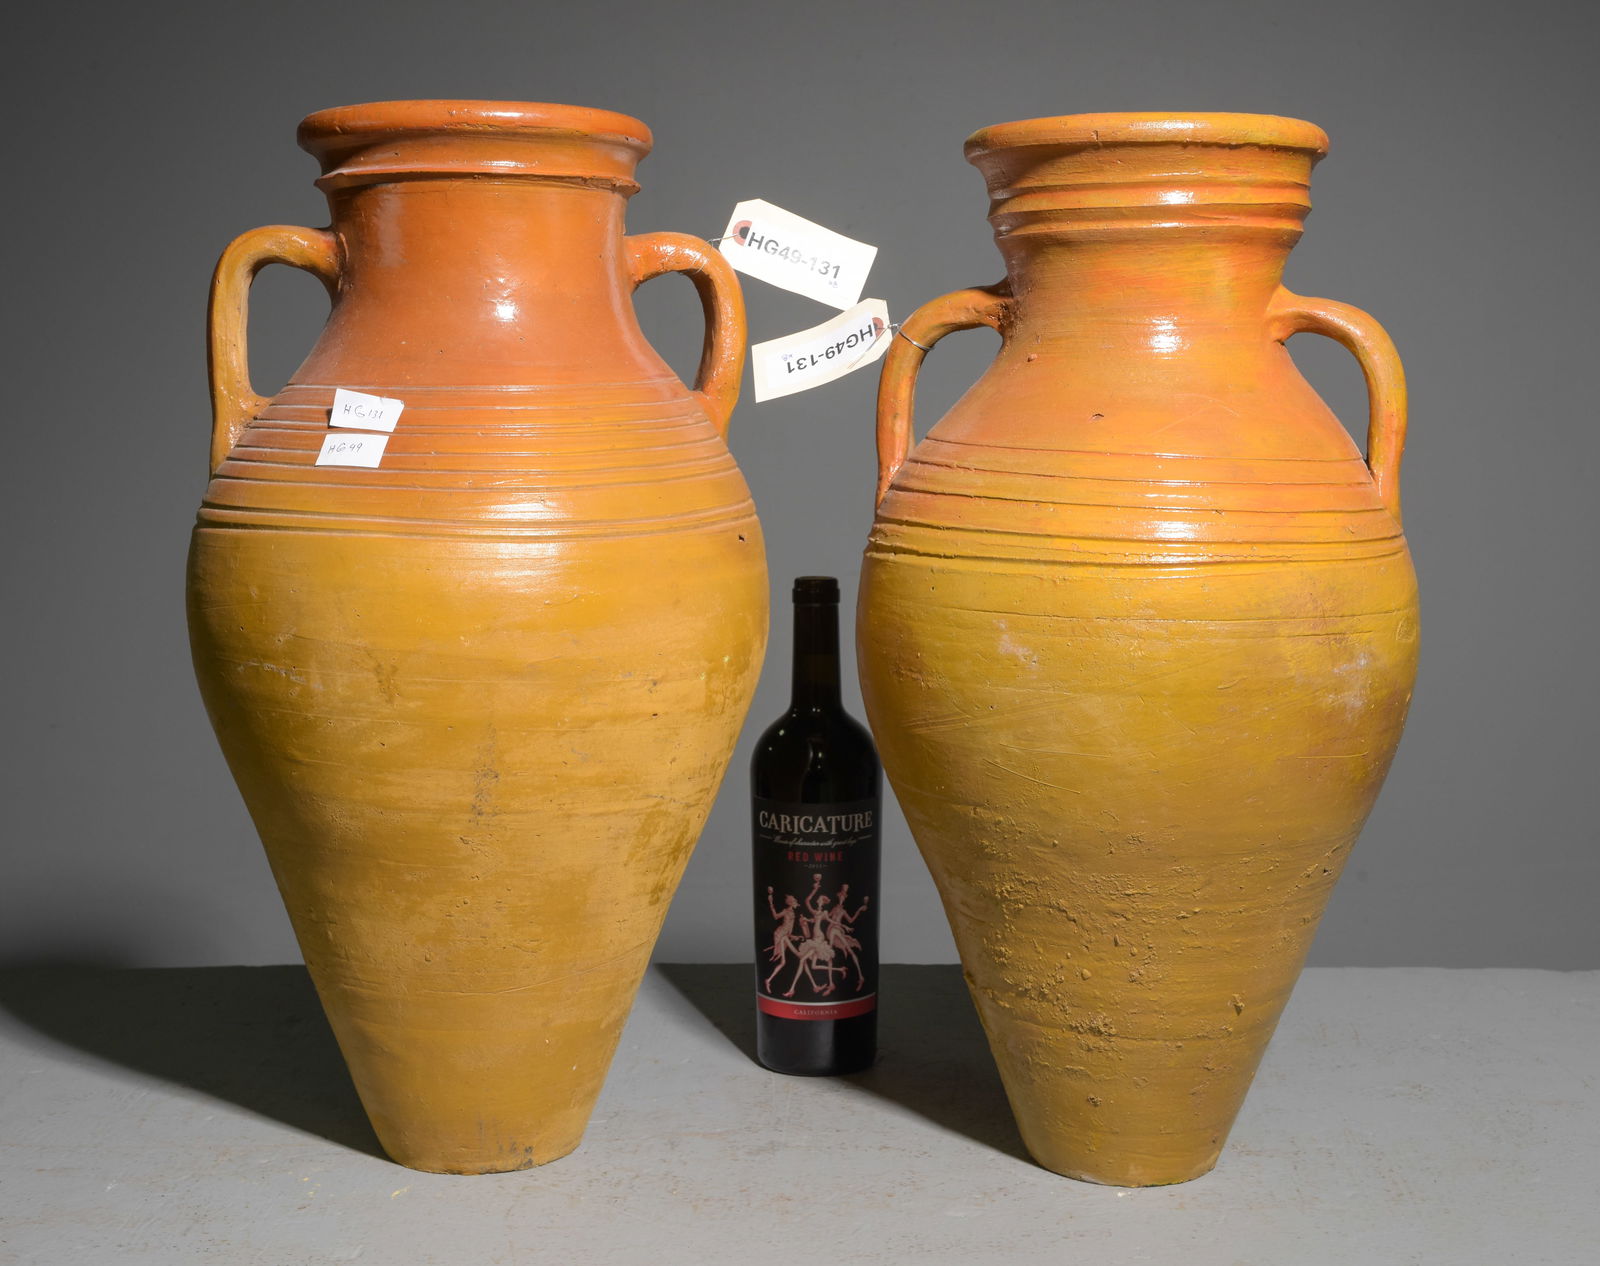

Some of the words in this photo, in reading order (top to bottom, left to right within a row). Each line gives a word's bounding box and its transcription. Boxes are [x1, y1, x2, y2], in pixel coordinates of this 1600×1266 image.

[747, 231, 841, 279] HG49-131
[787, 324, 873, 374] HG49-131
[759, 810, 873, 835] CARICATURE
[787, 851, 809, 862] RED
[814, 851, 843, 862] WINE
